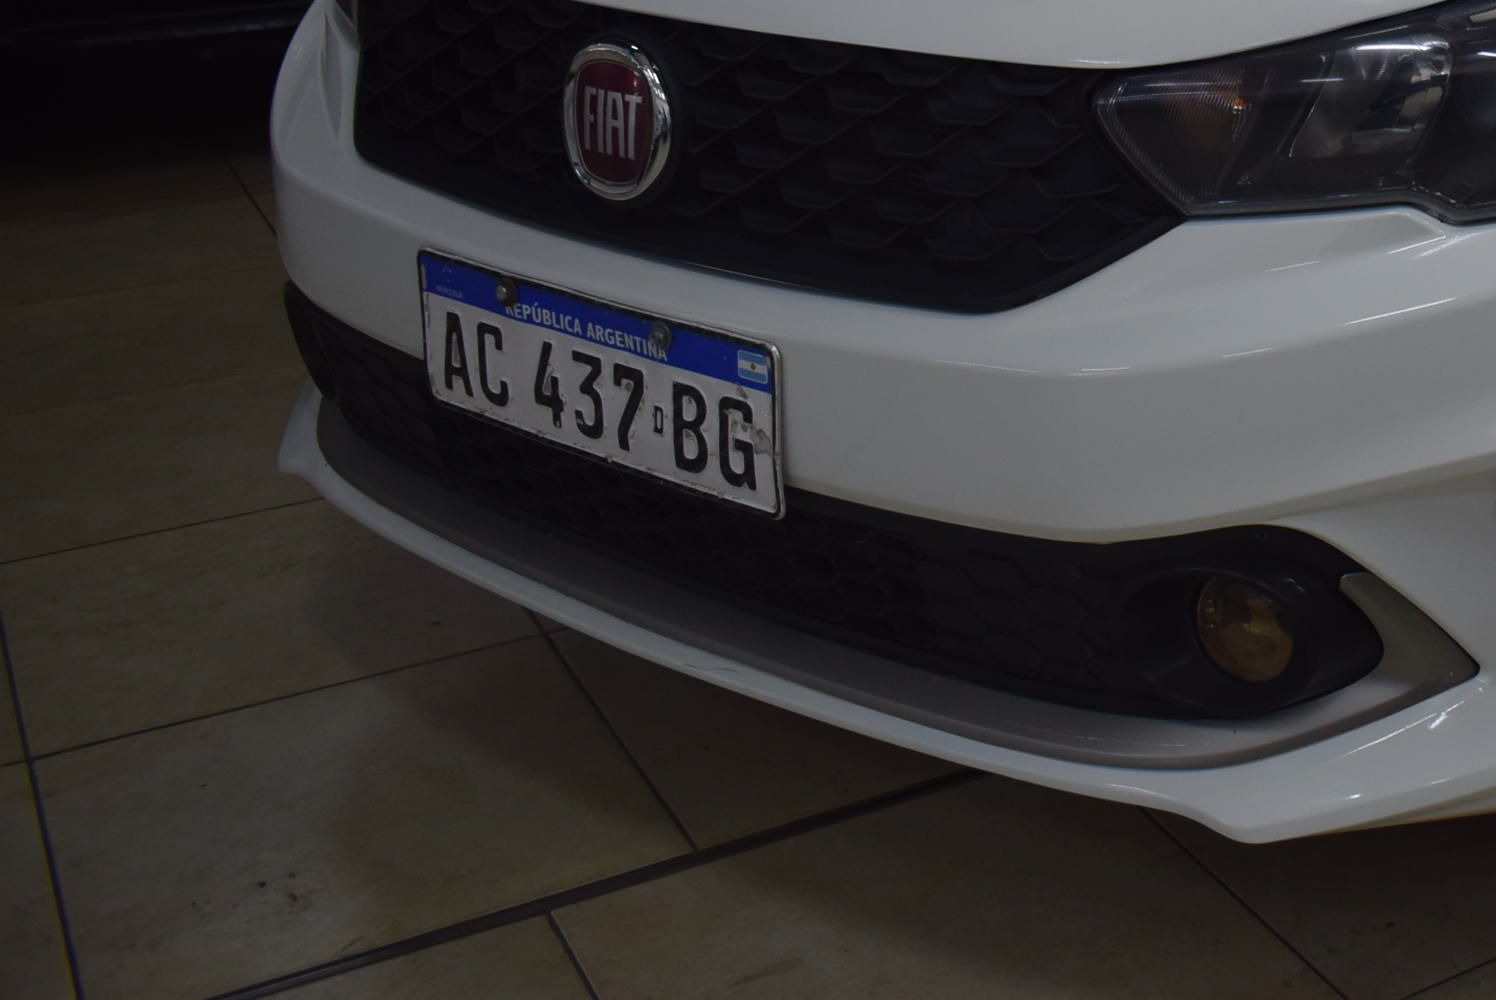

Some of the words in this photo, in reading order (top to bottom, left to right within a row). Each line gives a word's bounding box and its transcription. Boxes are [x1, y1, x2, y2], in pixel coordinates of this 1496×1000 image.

[584, 86, 643, 161] FIAT
[586, 322, 668, 362] ARGENTINA
[444, 311, 510, 407] AC
[534, 341, 645, 452] 437
[672, 381, 757, 491] BG
